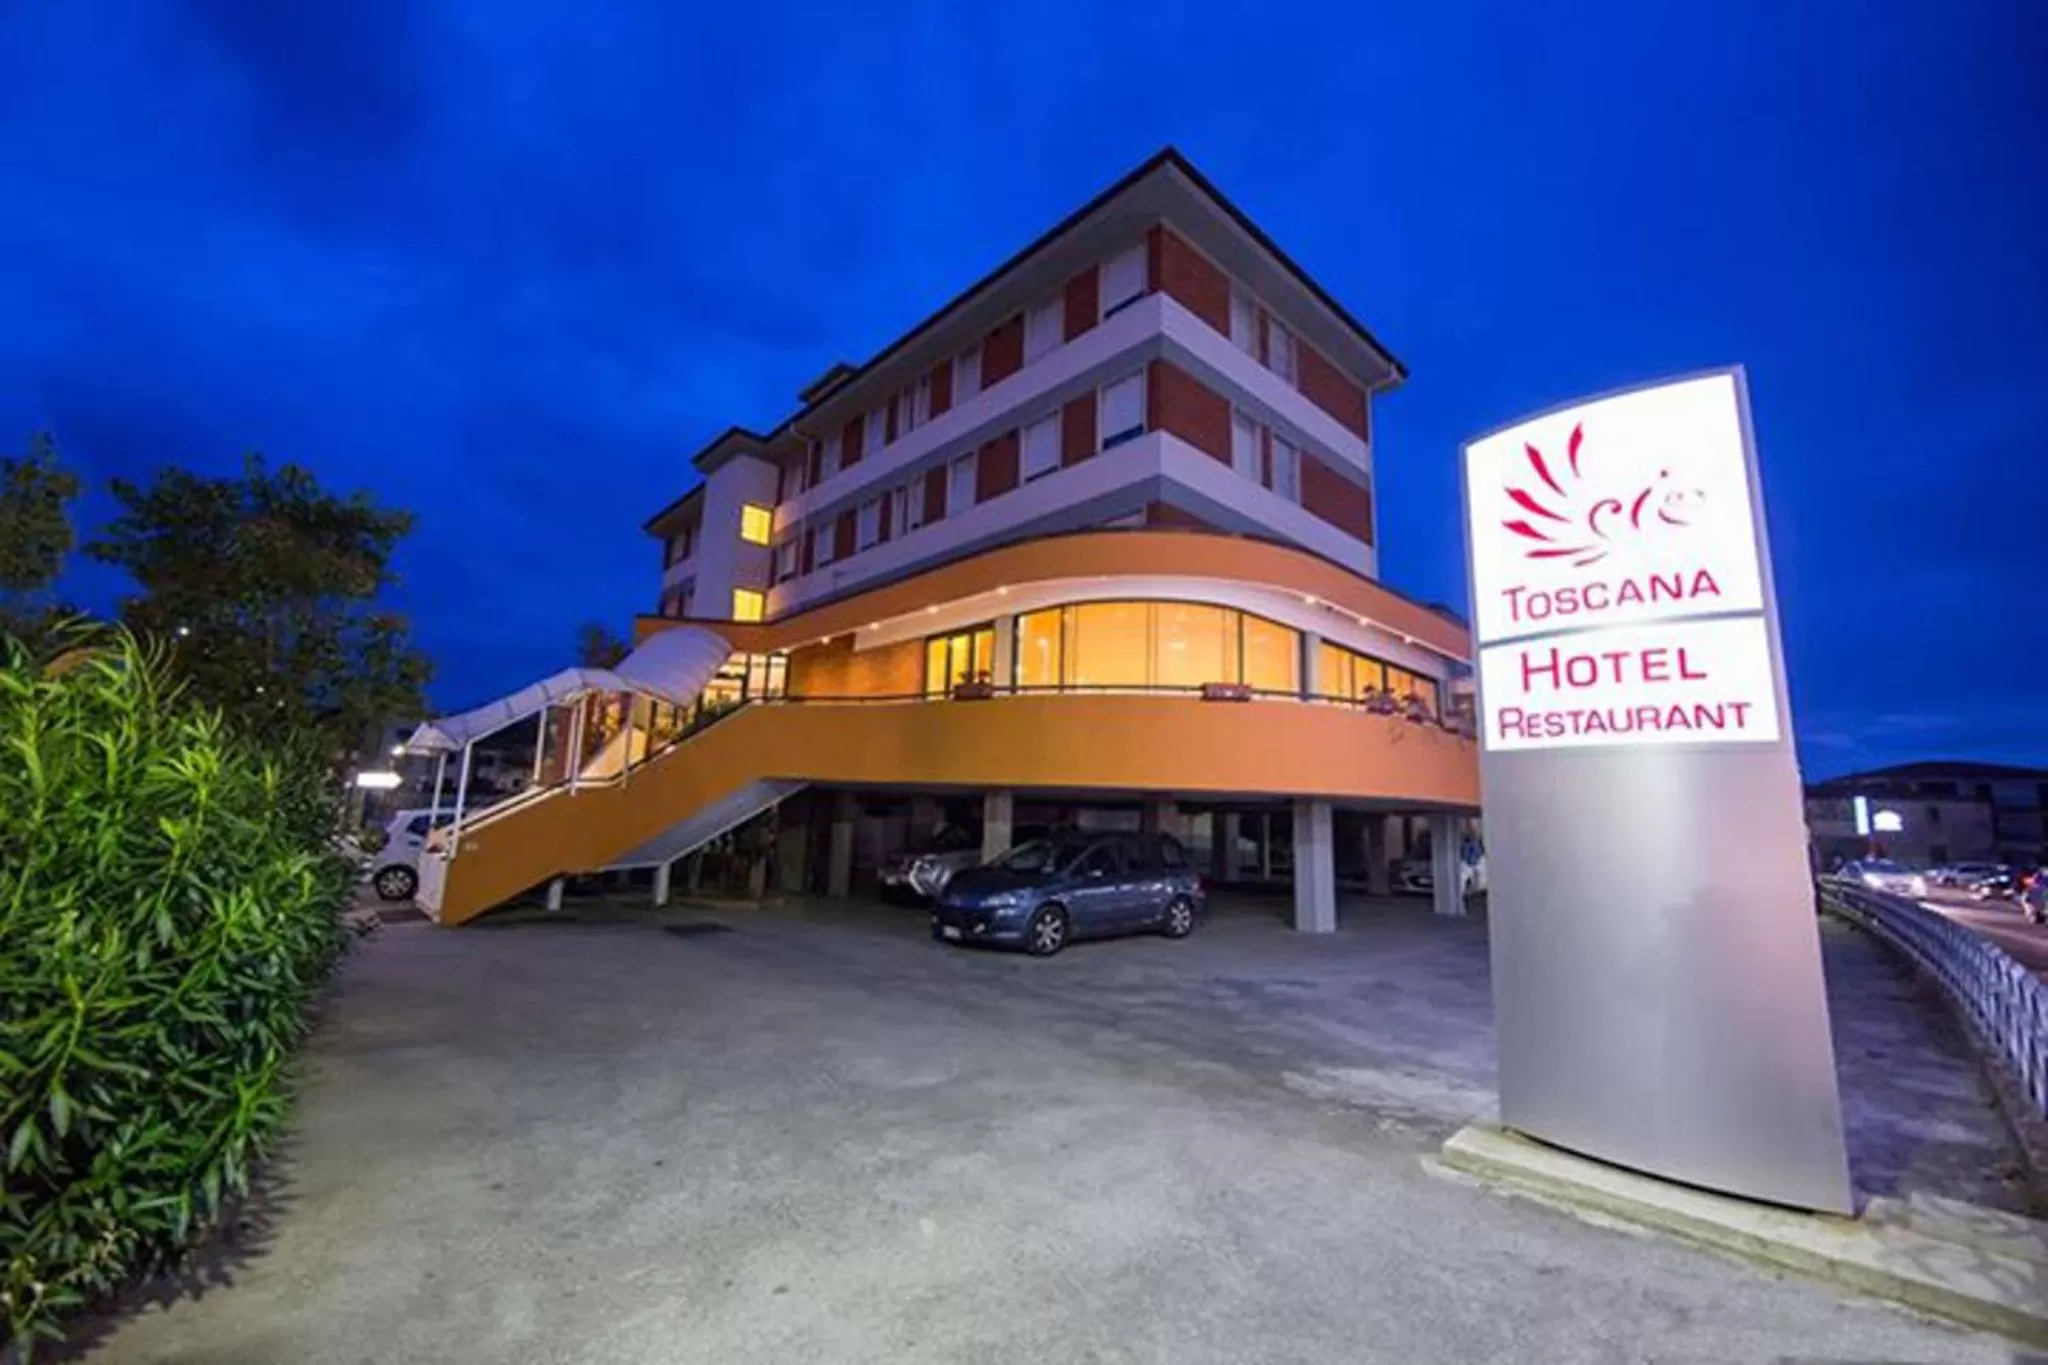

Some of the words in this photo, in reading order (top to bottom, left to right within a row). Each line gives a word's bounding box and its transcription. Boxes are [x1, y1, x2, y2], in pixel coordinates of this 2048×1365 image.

[1502, 568, 1721, 622] TOSCANA
[1520, 647, 1708, 693] HOTEL
[1498, 702, 1751, 739] RESTAURANT
